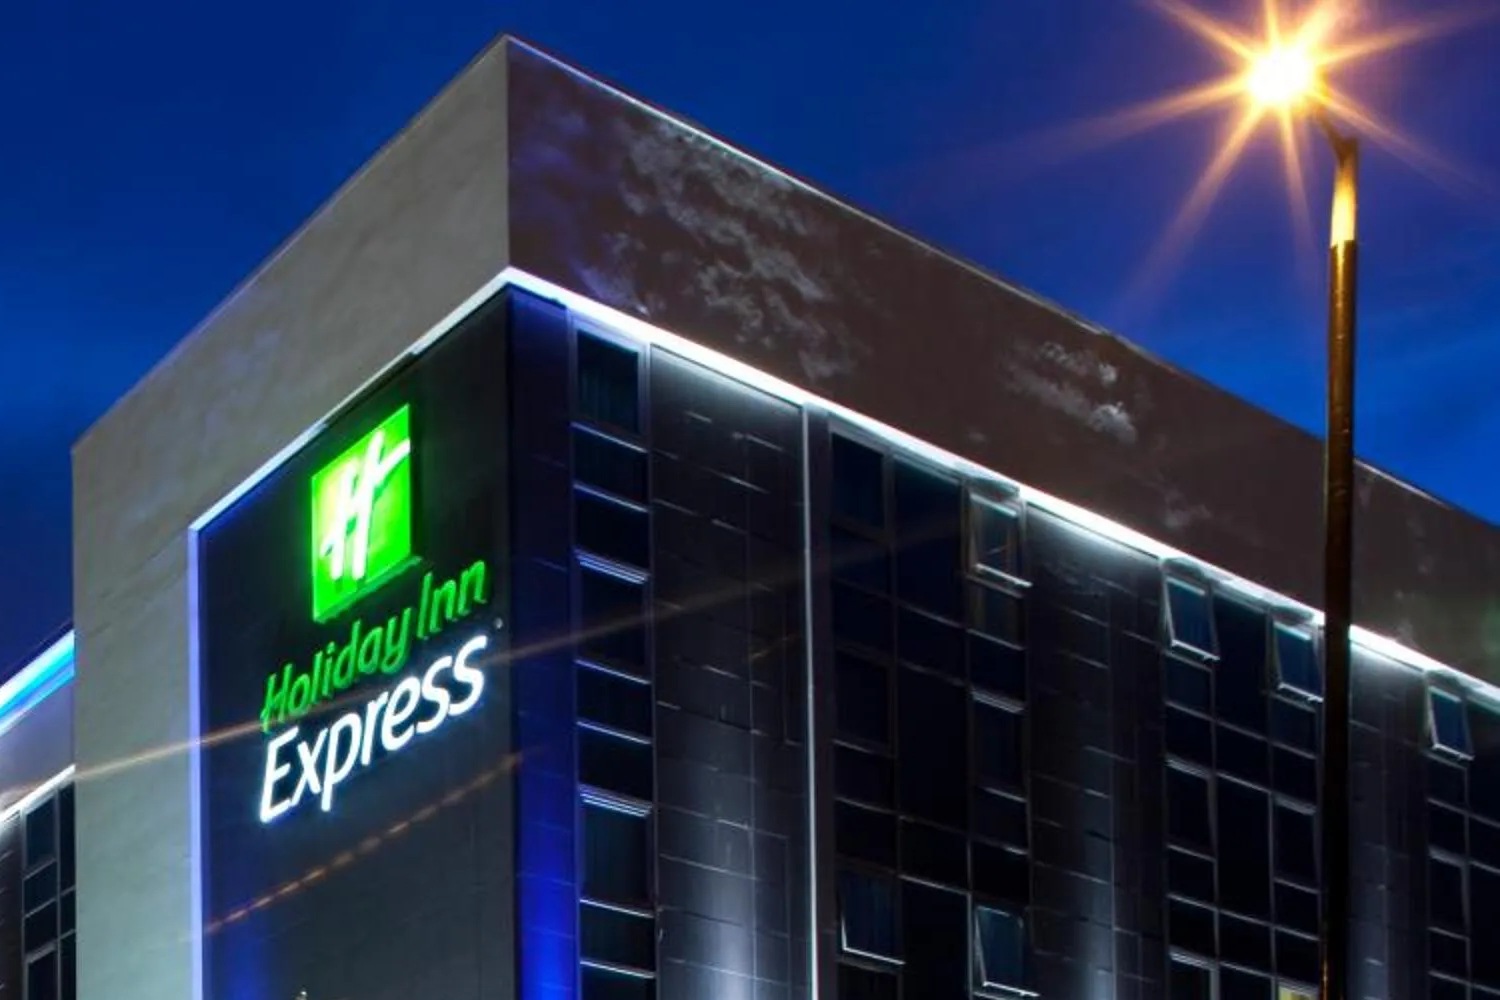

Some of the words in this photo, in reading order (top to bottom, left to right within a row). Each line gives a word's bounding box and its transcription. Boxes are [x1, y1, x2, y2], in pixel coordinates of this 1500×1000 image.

[260, 607, 410, 734] Holiday
[416, 560, 487, 640] Inn
[260, 635, 488, 822] Express
